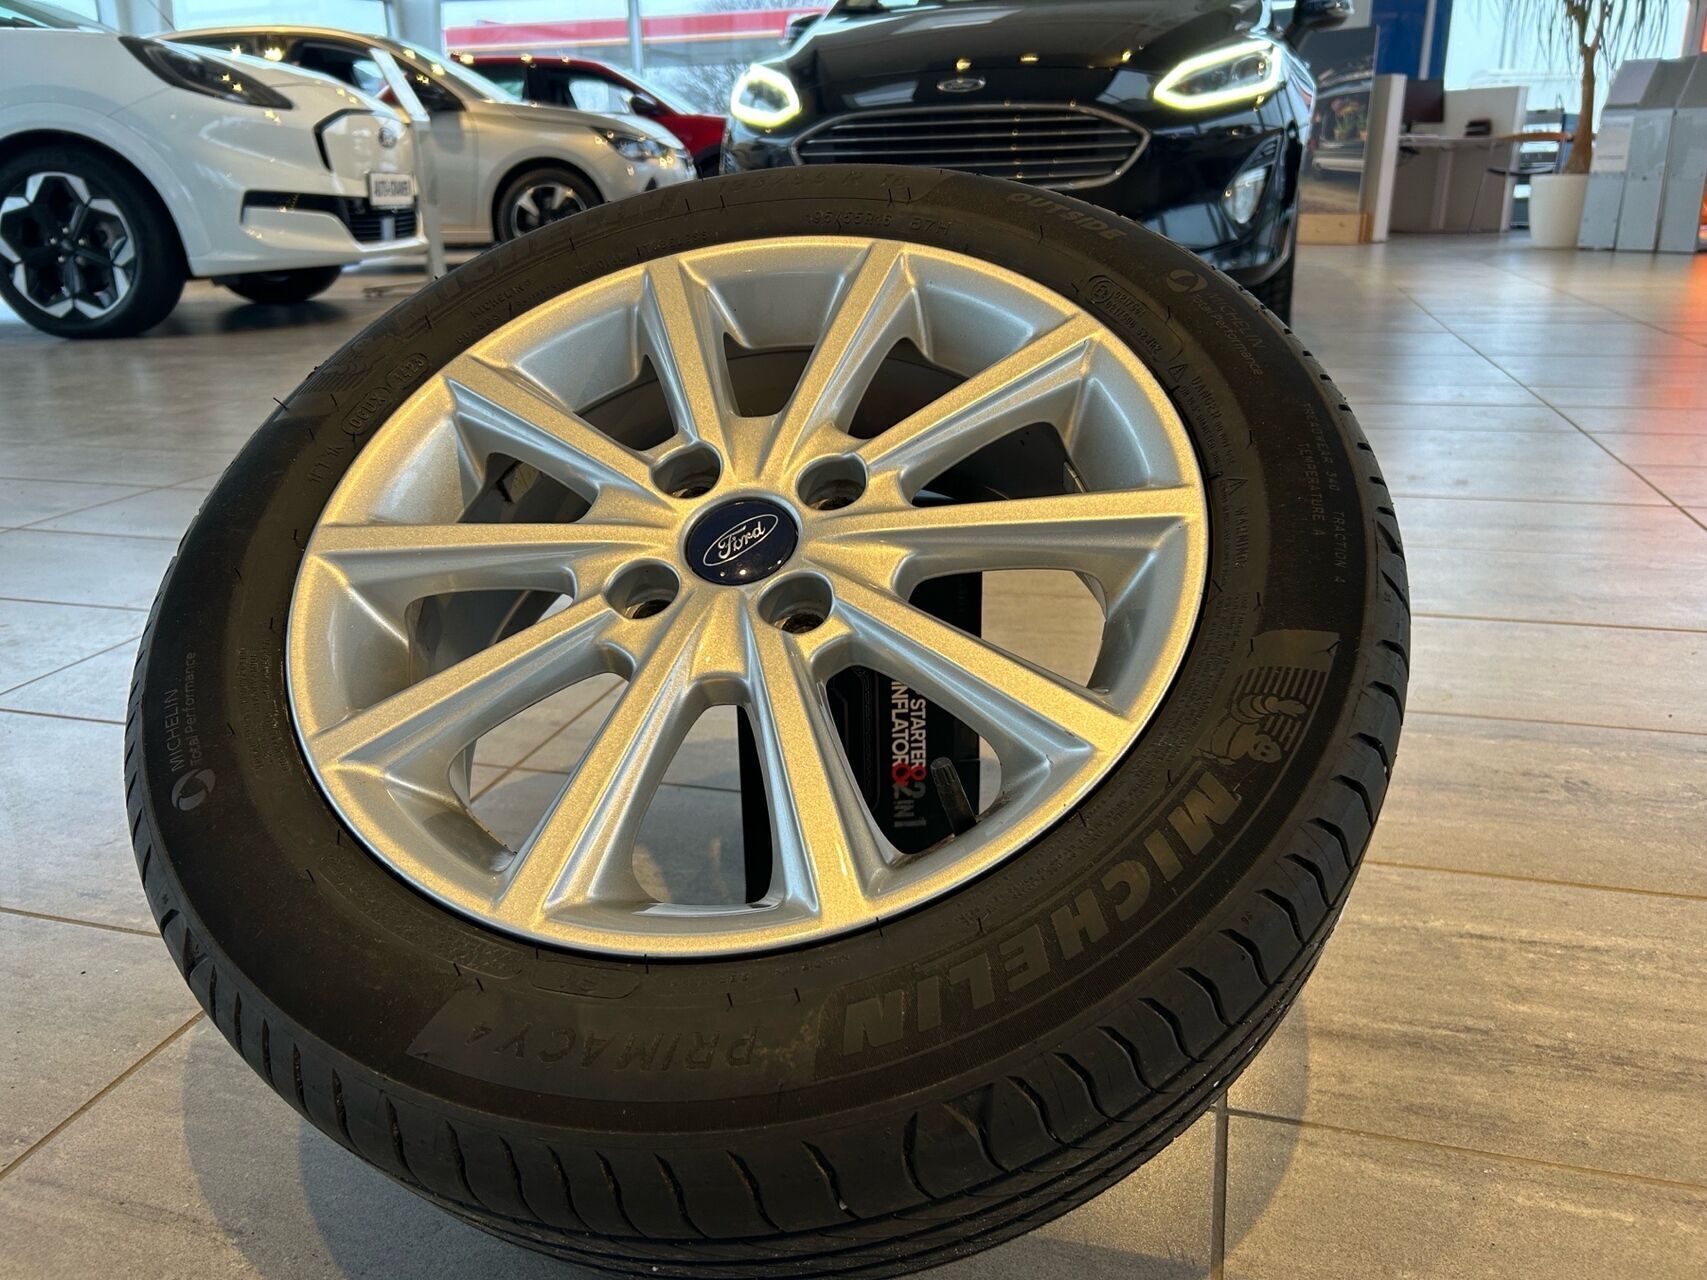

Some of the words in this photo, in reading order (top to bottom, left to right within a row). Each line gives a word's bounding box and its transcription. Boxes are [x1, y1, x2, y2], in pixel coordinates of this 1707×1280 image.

[1006, 192, 1129, 240] OUTSIDE
[1206, 293, 1266, 348] MICHELIN
[1297, 442, 1325, 521] TEMPERATURE
[717, 520, 766, 560] Ford
[1332, 510, 1347, 568] TRACTION
[182, 651, 198, 734] Performance
[162, 687, 185, 773] MICHELIN
[909, 698, 927, 771] STARTER
[842, 770, 1244, 1058] MICHELIN
[493, 1018, 760, 1072] PRIMACY
